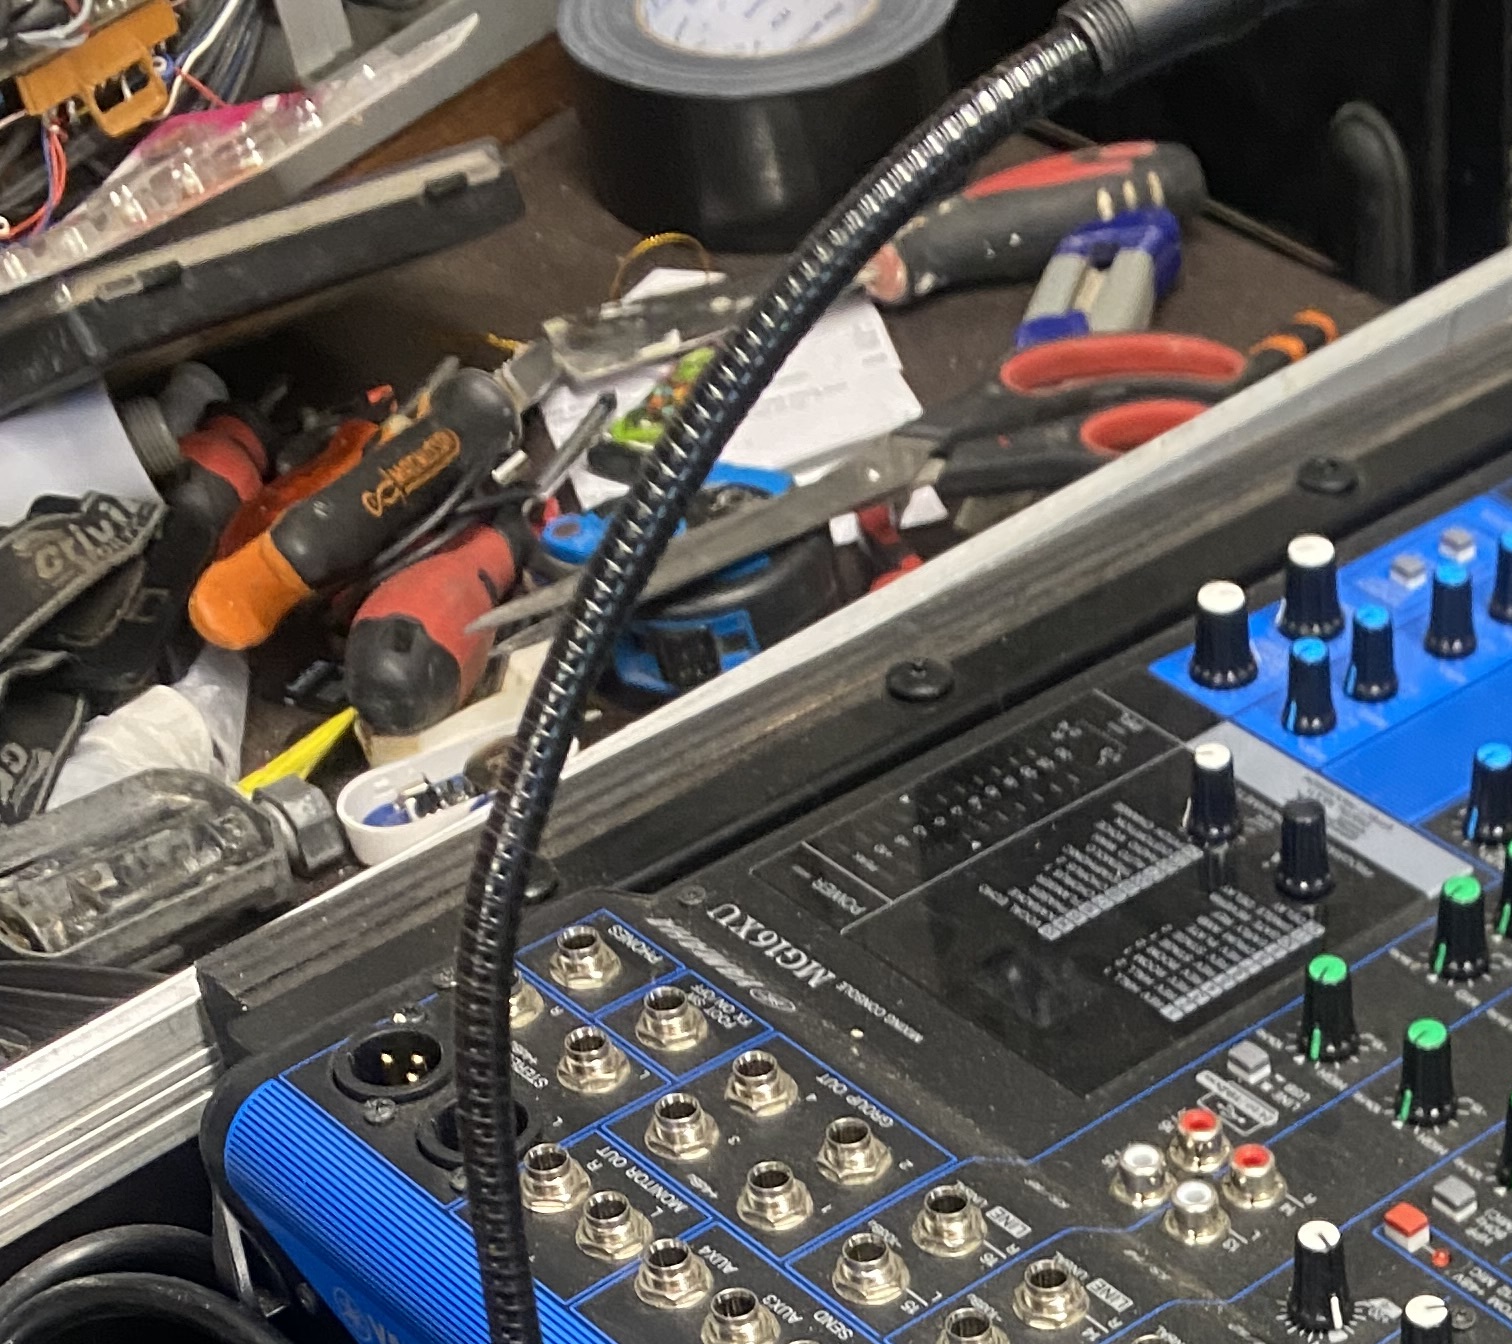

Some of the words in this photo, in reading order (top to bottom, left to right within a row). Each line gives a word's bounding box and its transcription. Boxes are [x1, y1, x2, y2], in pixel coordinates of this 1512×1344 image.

[608, 925, 663, 963] PHONES
[707, 901, 837, 989] MG16XU
[836, 981, 886, 1017] CONSOLE
[816, 1073, 847, 1095] OUT
[846, 1095, 893, 1127] GROUP
[596, 1146, 627, 1168] OUT
[625, 1166, 689, 1213] MONITOR
[987, 1206, 1029, 1237] LINE
[698, 1245, 738, 1274] AUX4
[762, 1294, 803, 1324] AUX3
[1087, 1278, 1131, 1311] LINE
[813, 1310, 853, 1340] SEND
